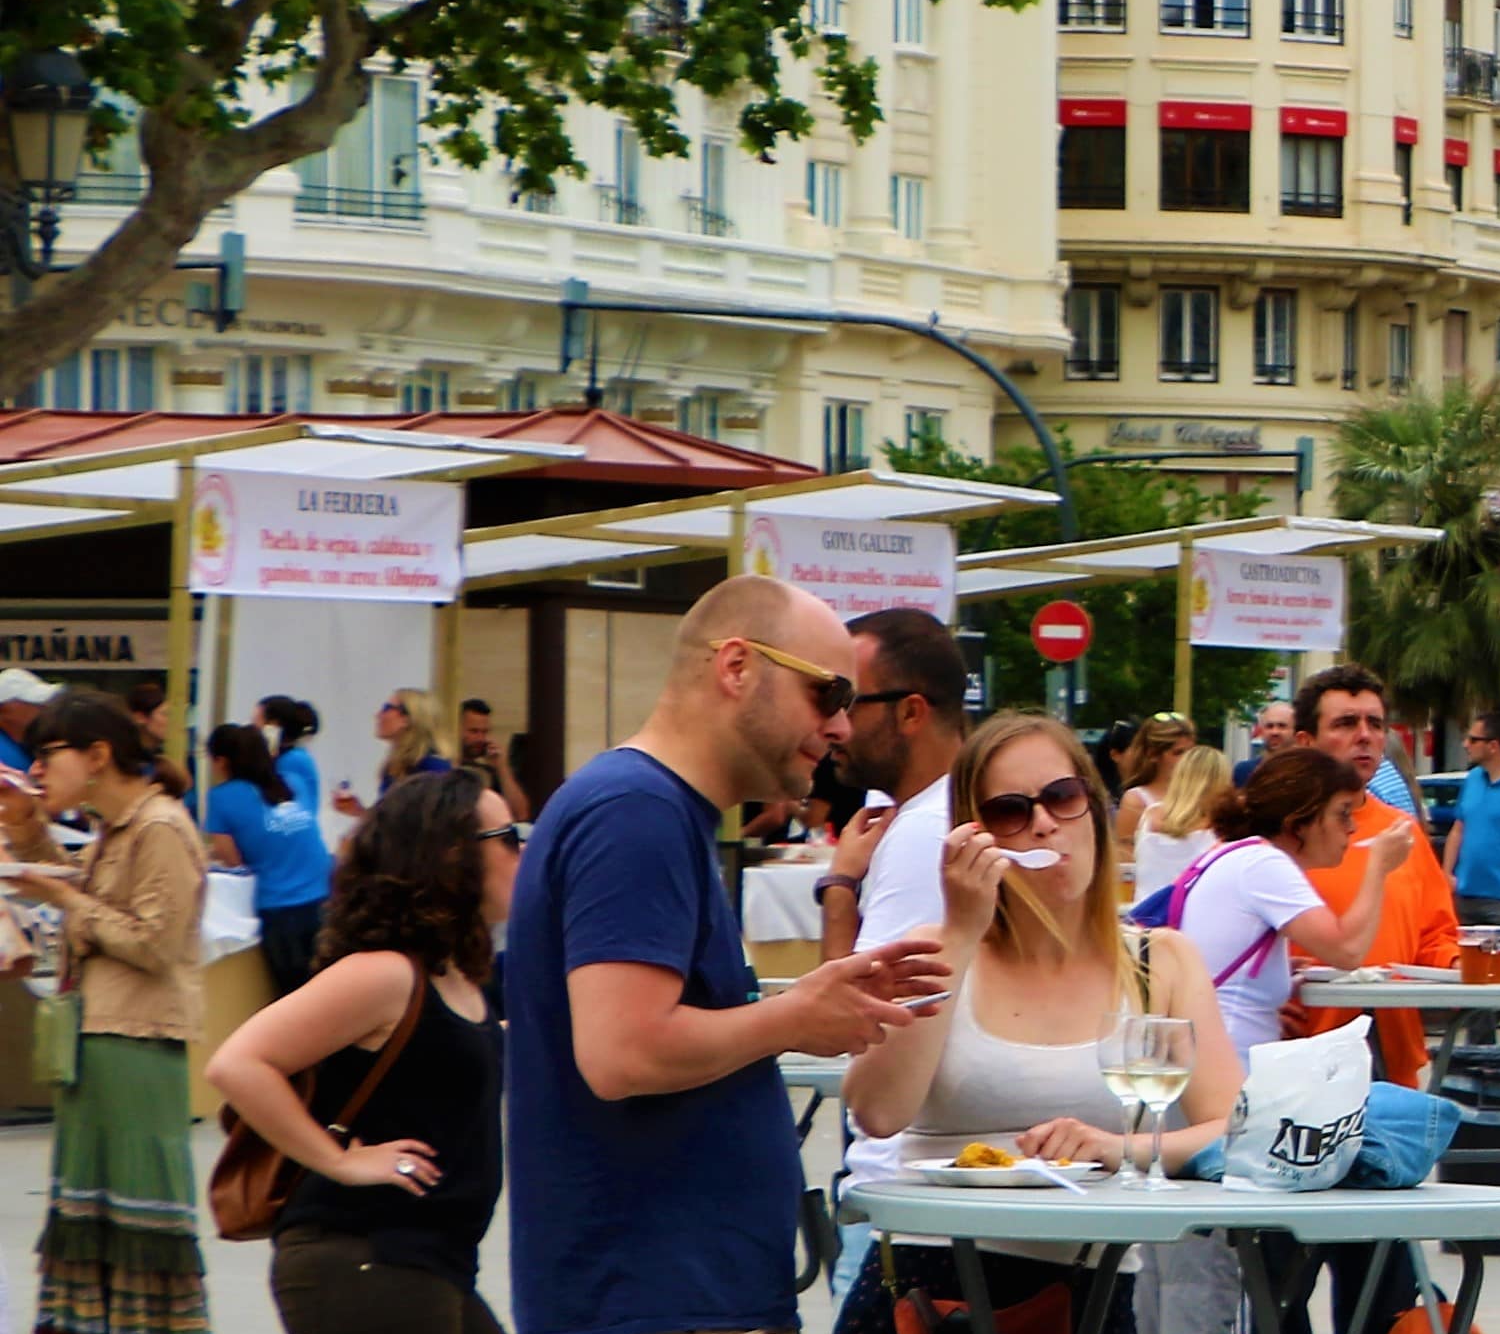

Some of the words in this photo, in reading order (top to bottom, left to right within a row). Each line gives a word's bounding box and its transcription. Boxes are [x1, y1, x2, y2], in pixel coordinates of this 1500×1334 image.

[297, 489, 317, 512] LA
[323, 491, 400, 516] FERRERA
[821, 530, 855, 552] GOYA
[859, 532, 914, 555] GALLERY
